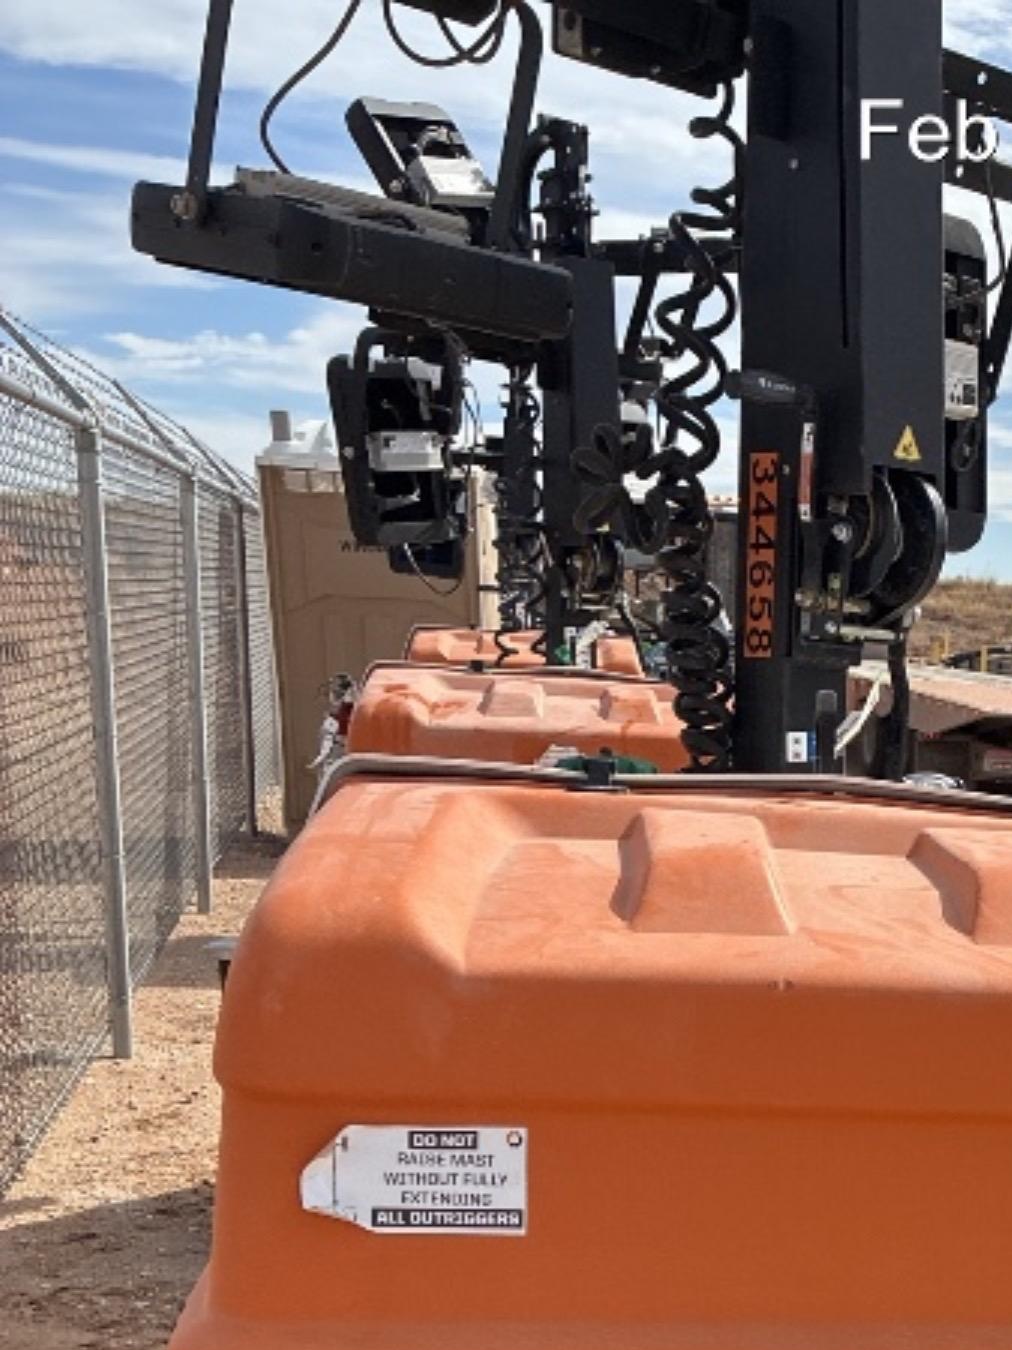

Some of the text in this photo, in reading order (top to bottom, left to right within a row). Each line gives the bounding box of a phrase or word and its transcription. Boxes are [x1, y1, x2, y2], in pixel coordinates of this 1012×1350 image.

[746, 458, 779, 656] 344658
[412, 1133, 475, 1147] DO NOT
[397, 1151, 494, 1168] RAISE MAST
[383, 1172, 508, 1187] WITHOUT FULLY
[401, 1191, 493, 1206] EXTENDING
[376, 1211, 521, 1225] ALL OUTRIGGERS
